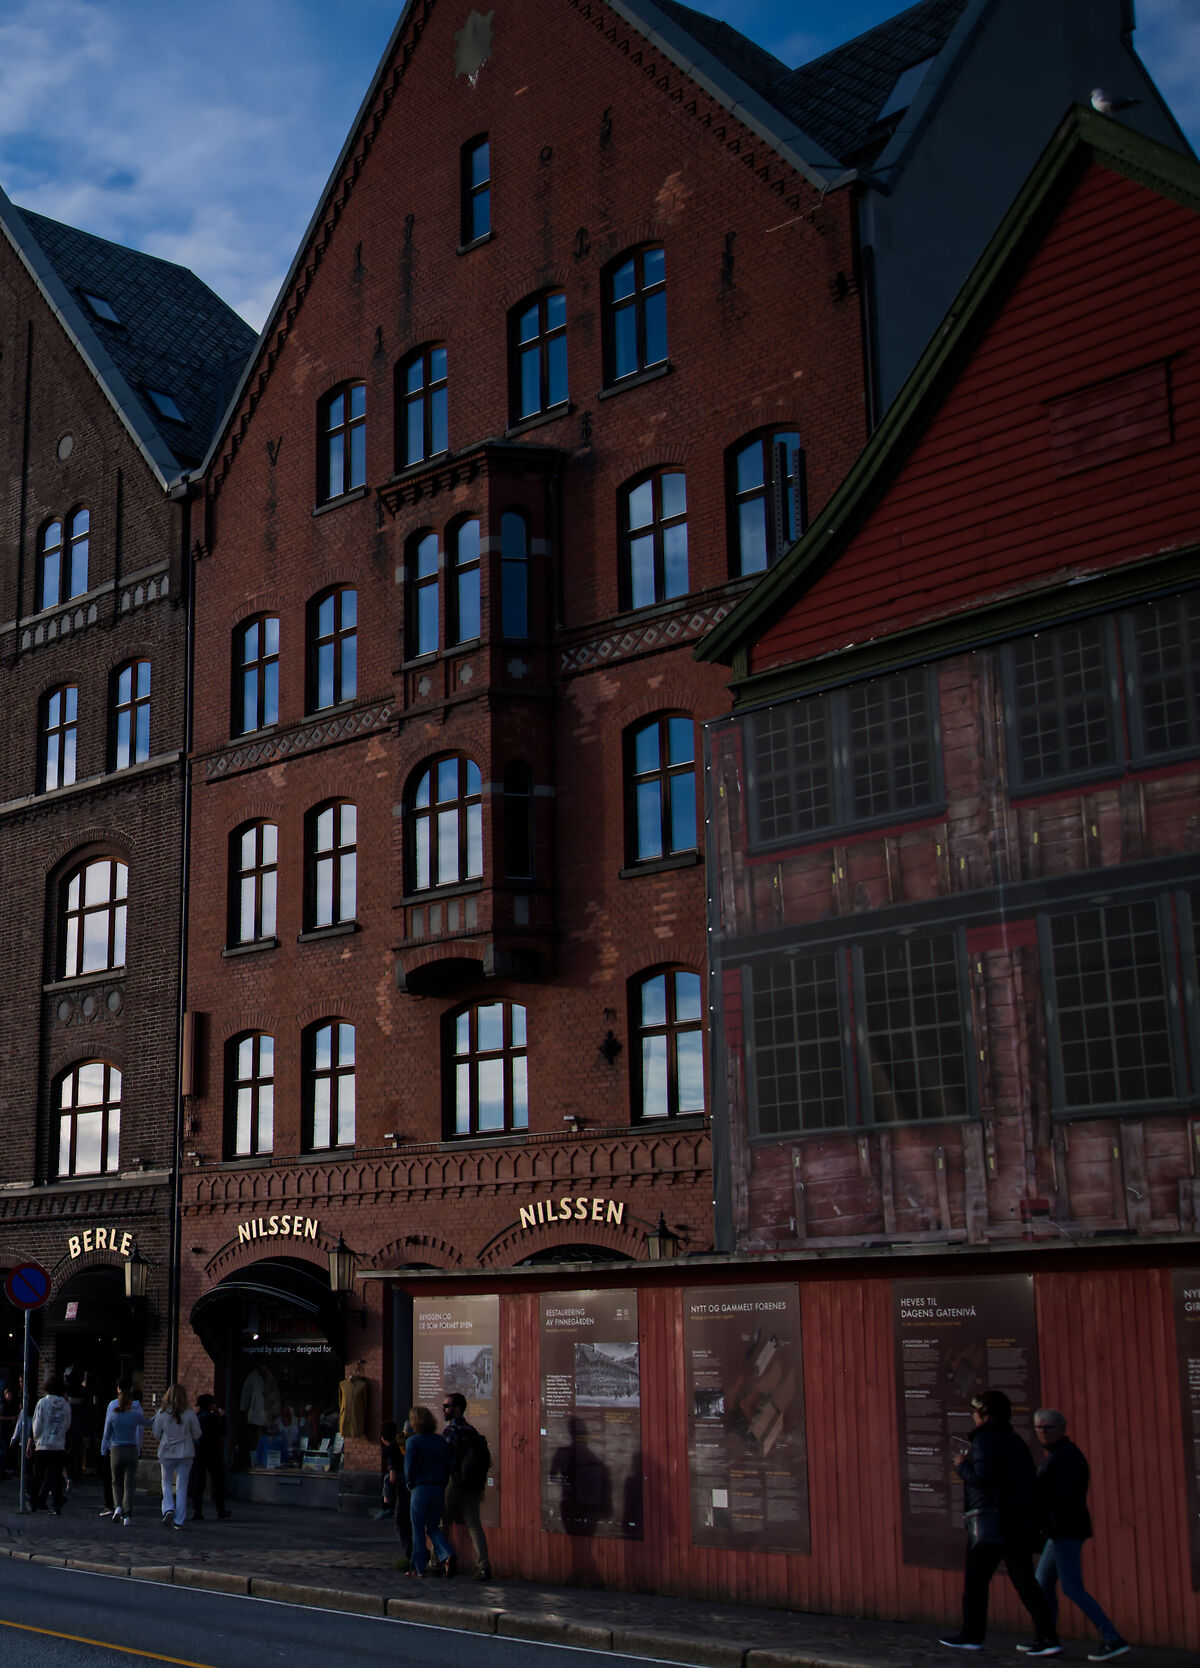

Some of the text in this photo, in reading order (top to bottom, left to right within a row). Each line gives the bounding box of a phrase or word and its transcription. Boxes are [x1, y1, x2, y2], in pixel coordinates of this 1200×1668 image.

[519, 1197, 624, 1229] NILSSEN
[237, 1214, 319, 1244] NILSSEN
[68, 1227, 133, 1260] BERLE
[690, 1301, 787, 1313] NYTT OG GAMMELT FORENES
[900, 1297, 938, 1306] HEVES TIL
[545, 1308, 586, 1317] RESTAURERING
[901, 1305, 977, 1318] DAGENS GATENIVÅ
[545, 1316, 595, 1326] AV FINNEGÅRDEN
[265, 1345, 272, 1355] by
[296, 1345, 322, 1355] designed
[322, 1345, 332, 1353] for
